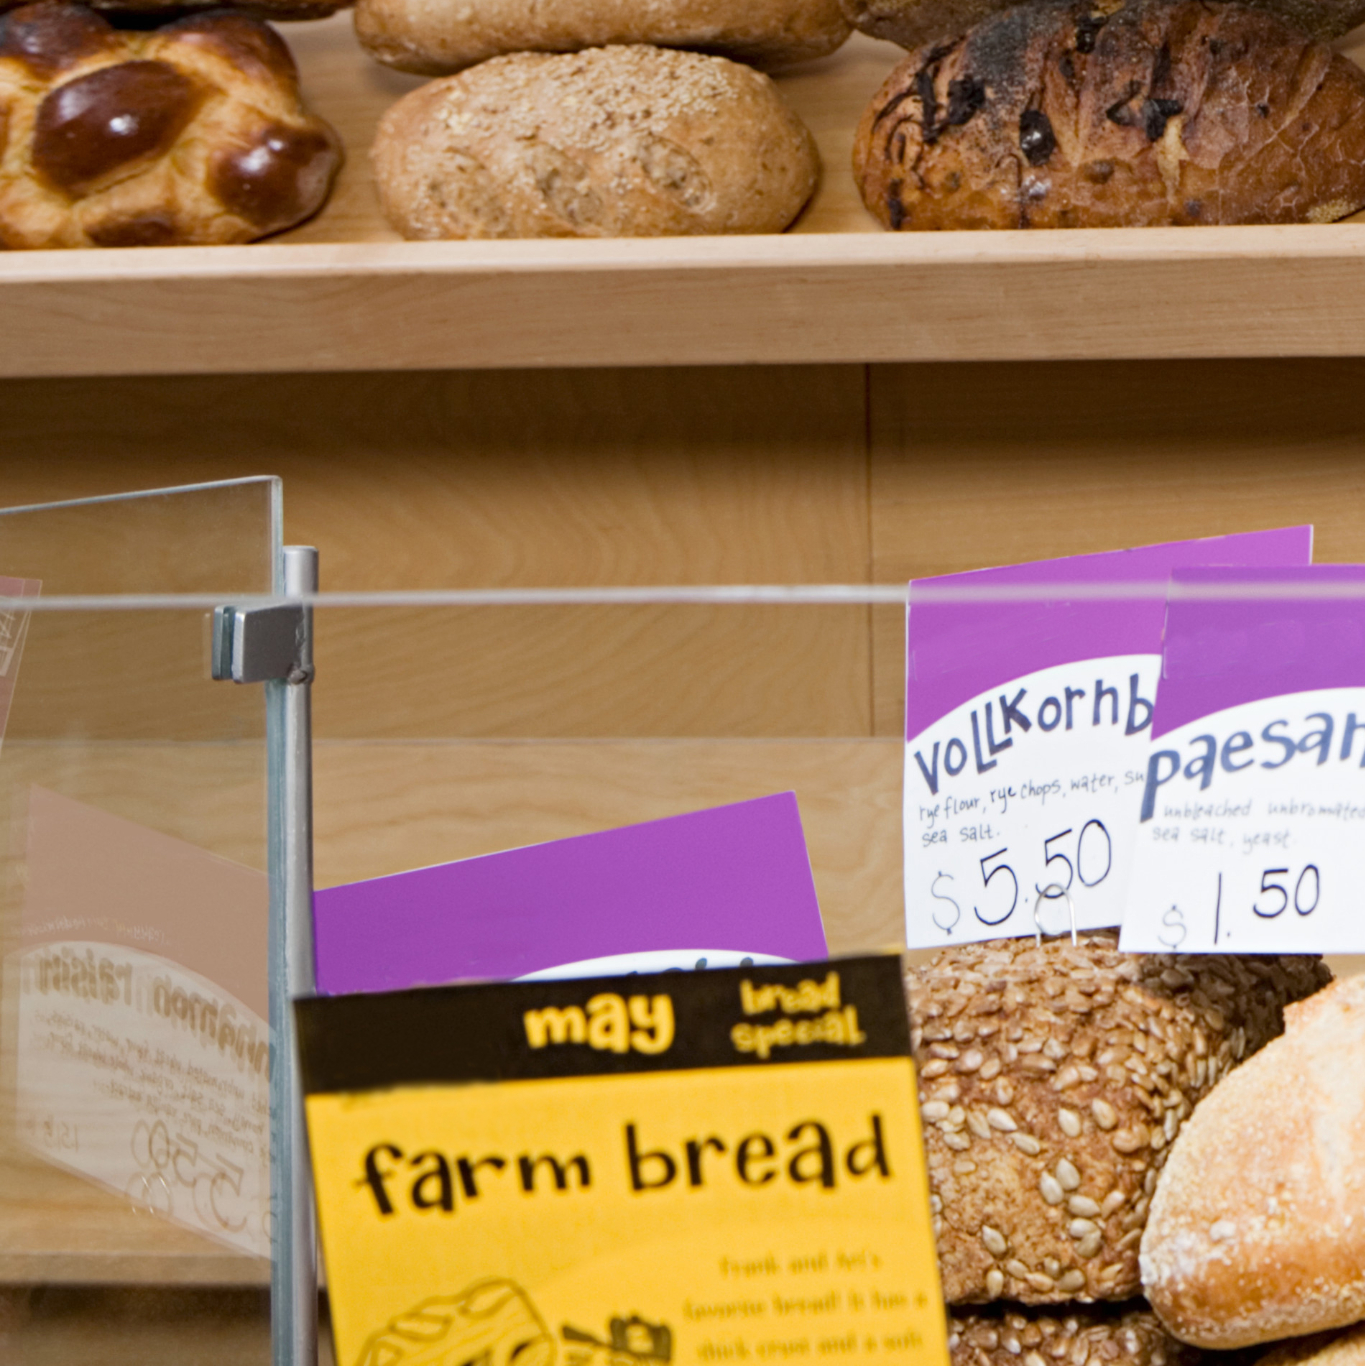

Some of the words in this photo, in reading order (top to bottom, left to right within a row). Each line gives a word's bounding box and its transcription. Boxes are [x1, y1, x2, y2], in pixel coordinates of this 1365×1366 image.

[989, 785, 1017, 815] rye
[921, 828, 948, 848] sea
[523, 992, 676, 1056] may
[740, 972, 841, 1015] bread
[730, 1005, 867, 1060] special
[356, 1141, 592, 1218] farm
[622, 1111, 895, 1195] bread
